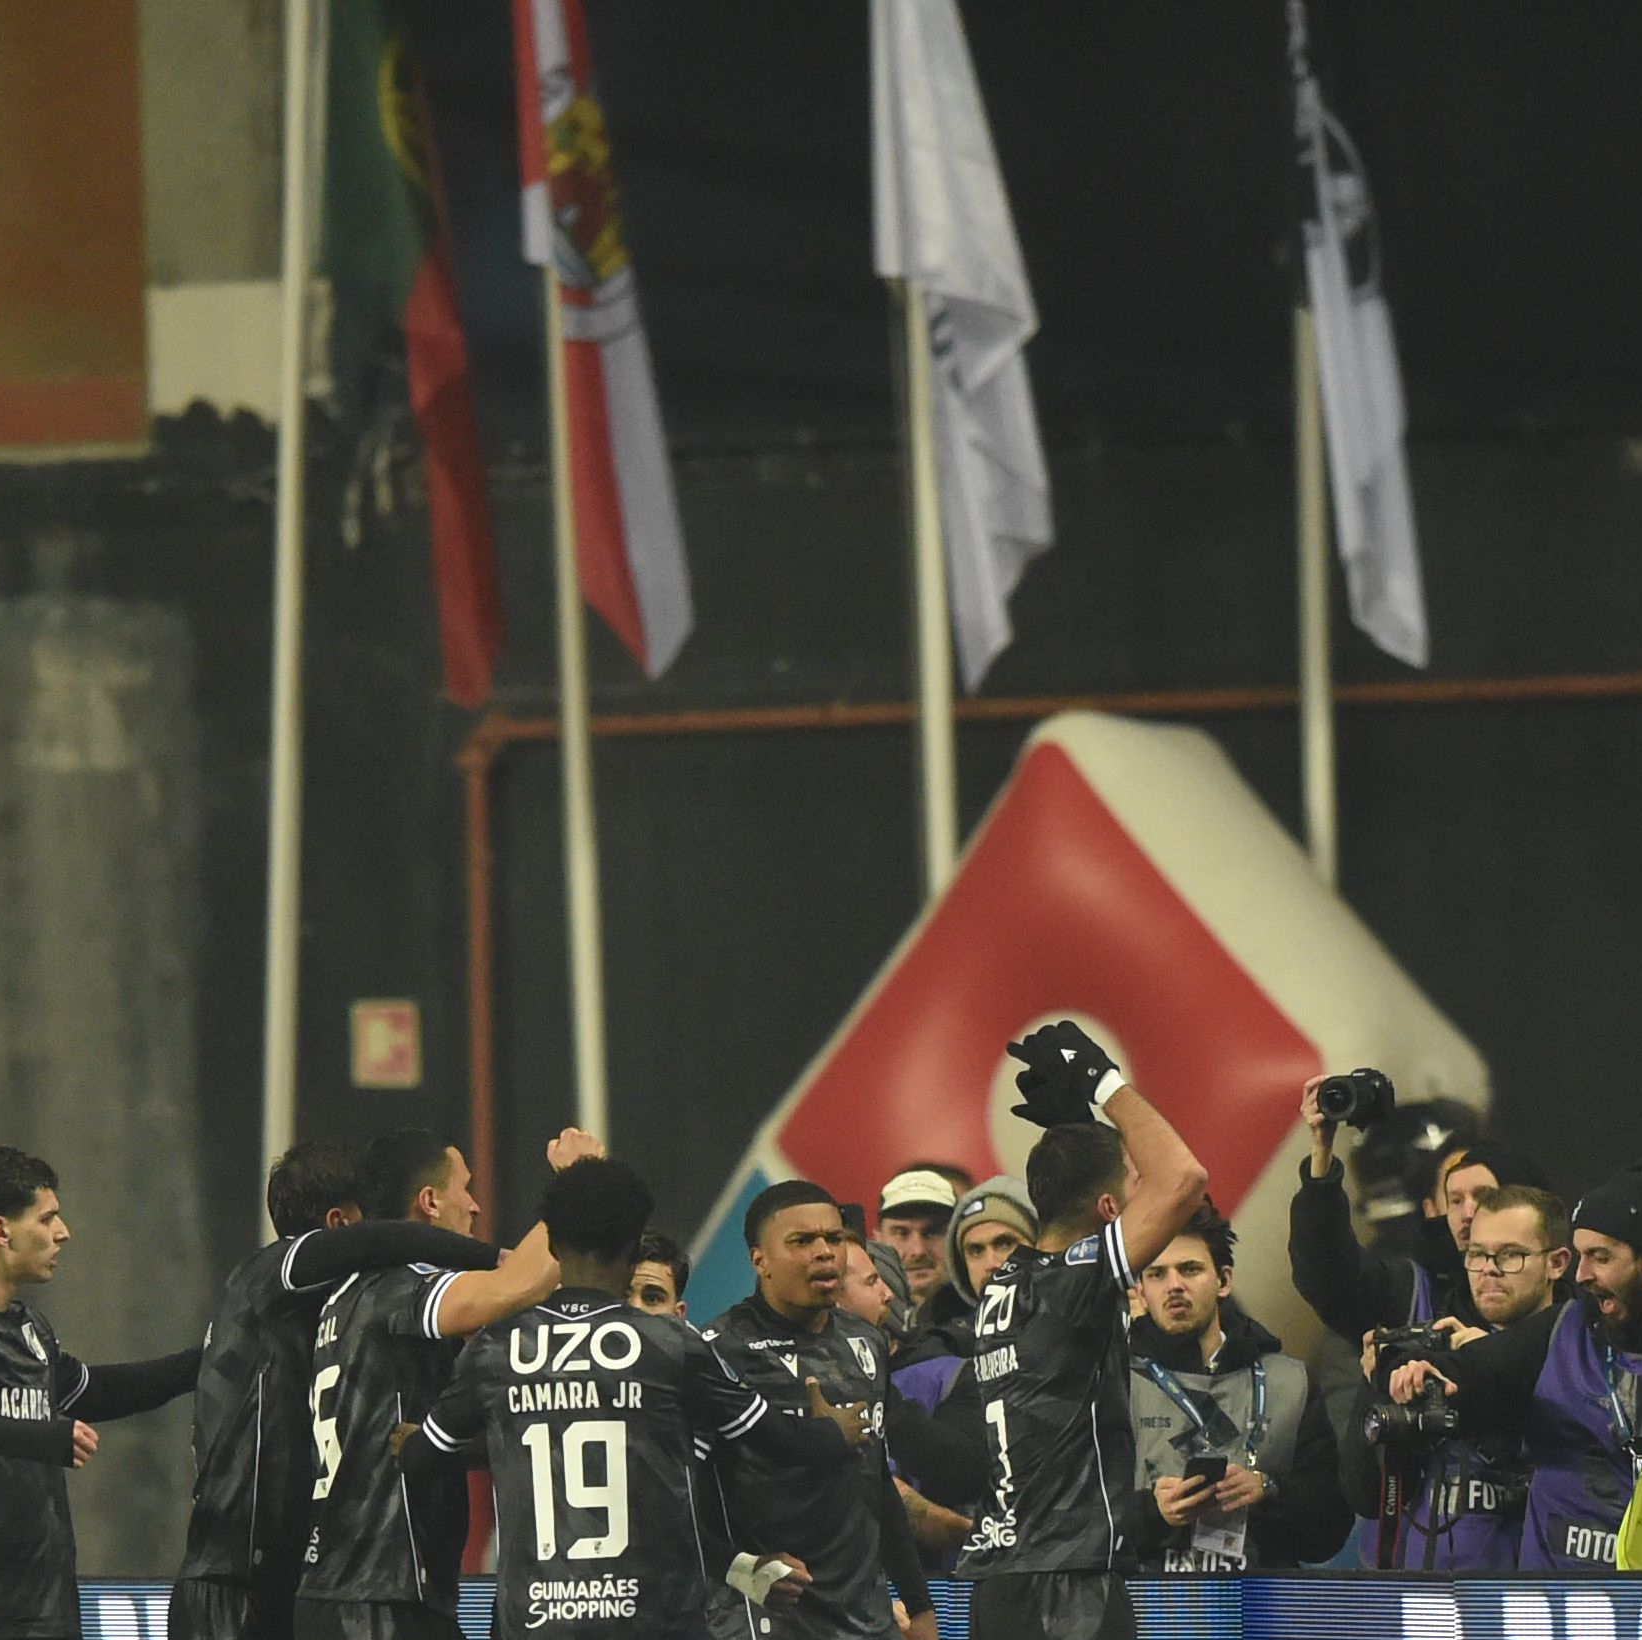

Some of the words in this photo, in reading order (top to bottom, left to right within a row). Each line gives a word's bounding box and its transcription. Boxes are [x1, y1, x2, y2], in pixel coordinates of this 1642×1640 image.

[509, 1321, 642, 1375] UZO
[508, 1380, 600, 1414] CAMARA
[612, 1381, 642, 1409] JR
[522, 1420, 629, 1561] 19
[1386, 1475, 1397, 1516] Canon
[1565, 1525, 1618, 1564] FOTO
[528, 1574, 639, 1601] GUIMARÃES
[525, 1599, 637, 1629] SHOPPING
